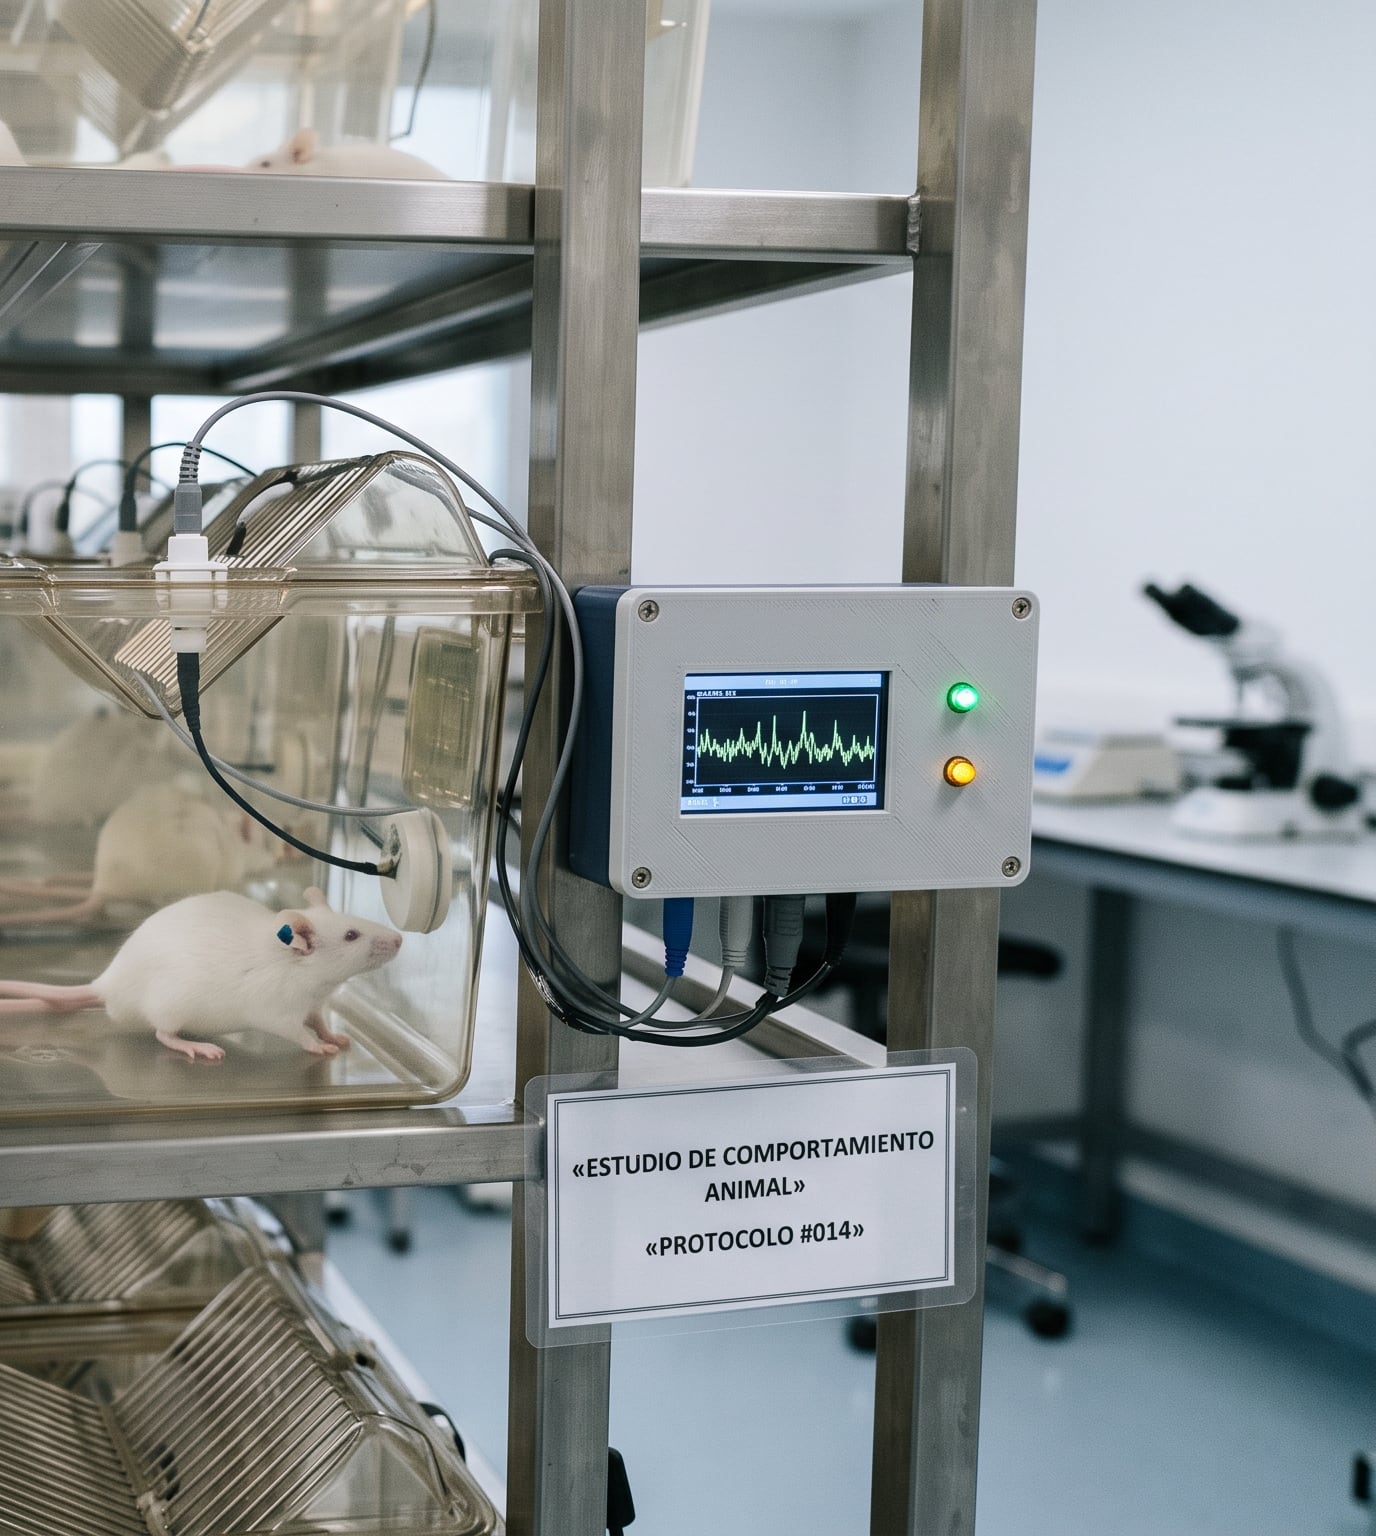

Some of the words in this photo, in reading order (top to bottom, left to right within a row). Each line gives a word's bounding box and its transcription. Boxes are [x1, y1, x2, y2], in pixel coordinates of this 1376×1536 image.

[572, 1151, 682, 1178] «ESTUDIO
[688, 1149, 717, 1169] DE
[722, 1130, 934, 1166] COMPORTAMIENTO
[704, 1176, 806, 1203] ANIMAL»
[645, 1226, 794, 1257] «PROTOCOLO
[800, 1220, 864, 1244] #014»
